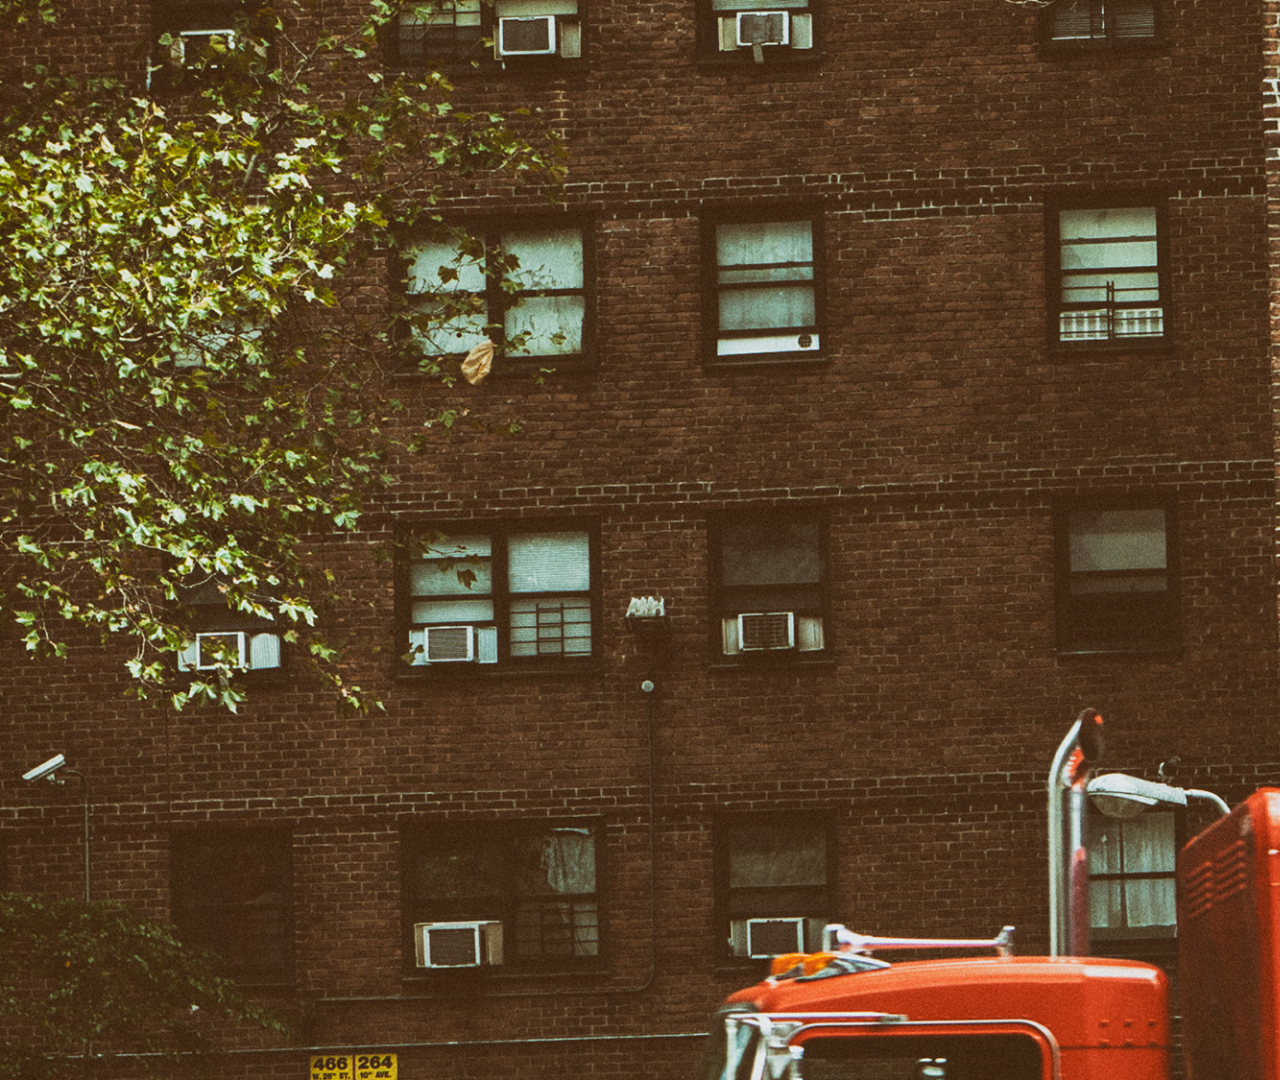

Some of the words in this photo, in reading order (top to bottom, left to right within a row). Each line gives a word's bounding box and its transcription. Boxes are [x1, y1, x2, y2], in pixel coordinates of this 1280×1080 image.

[313, 1057, 348, 1071] 466
[358, 1055, 393, 1069] 264
[375, 1071, 392, 1079] AVE.
